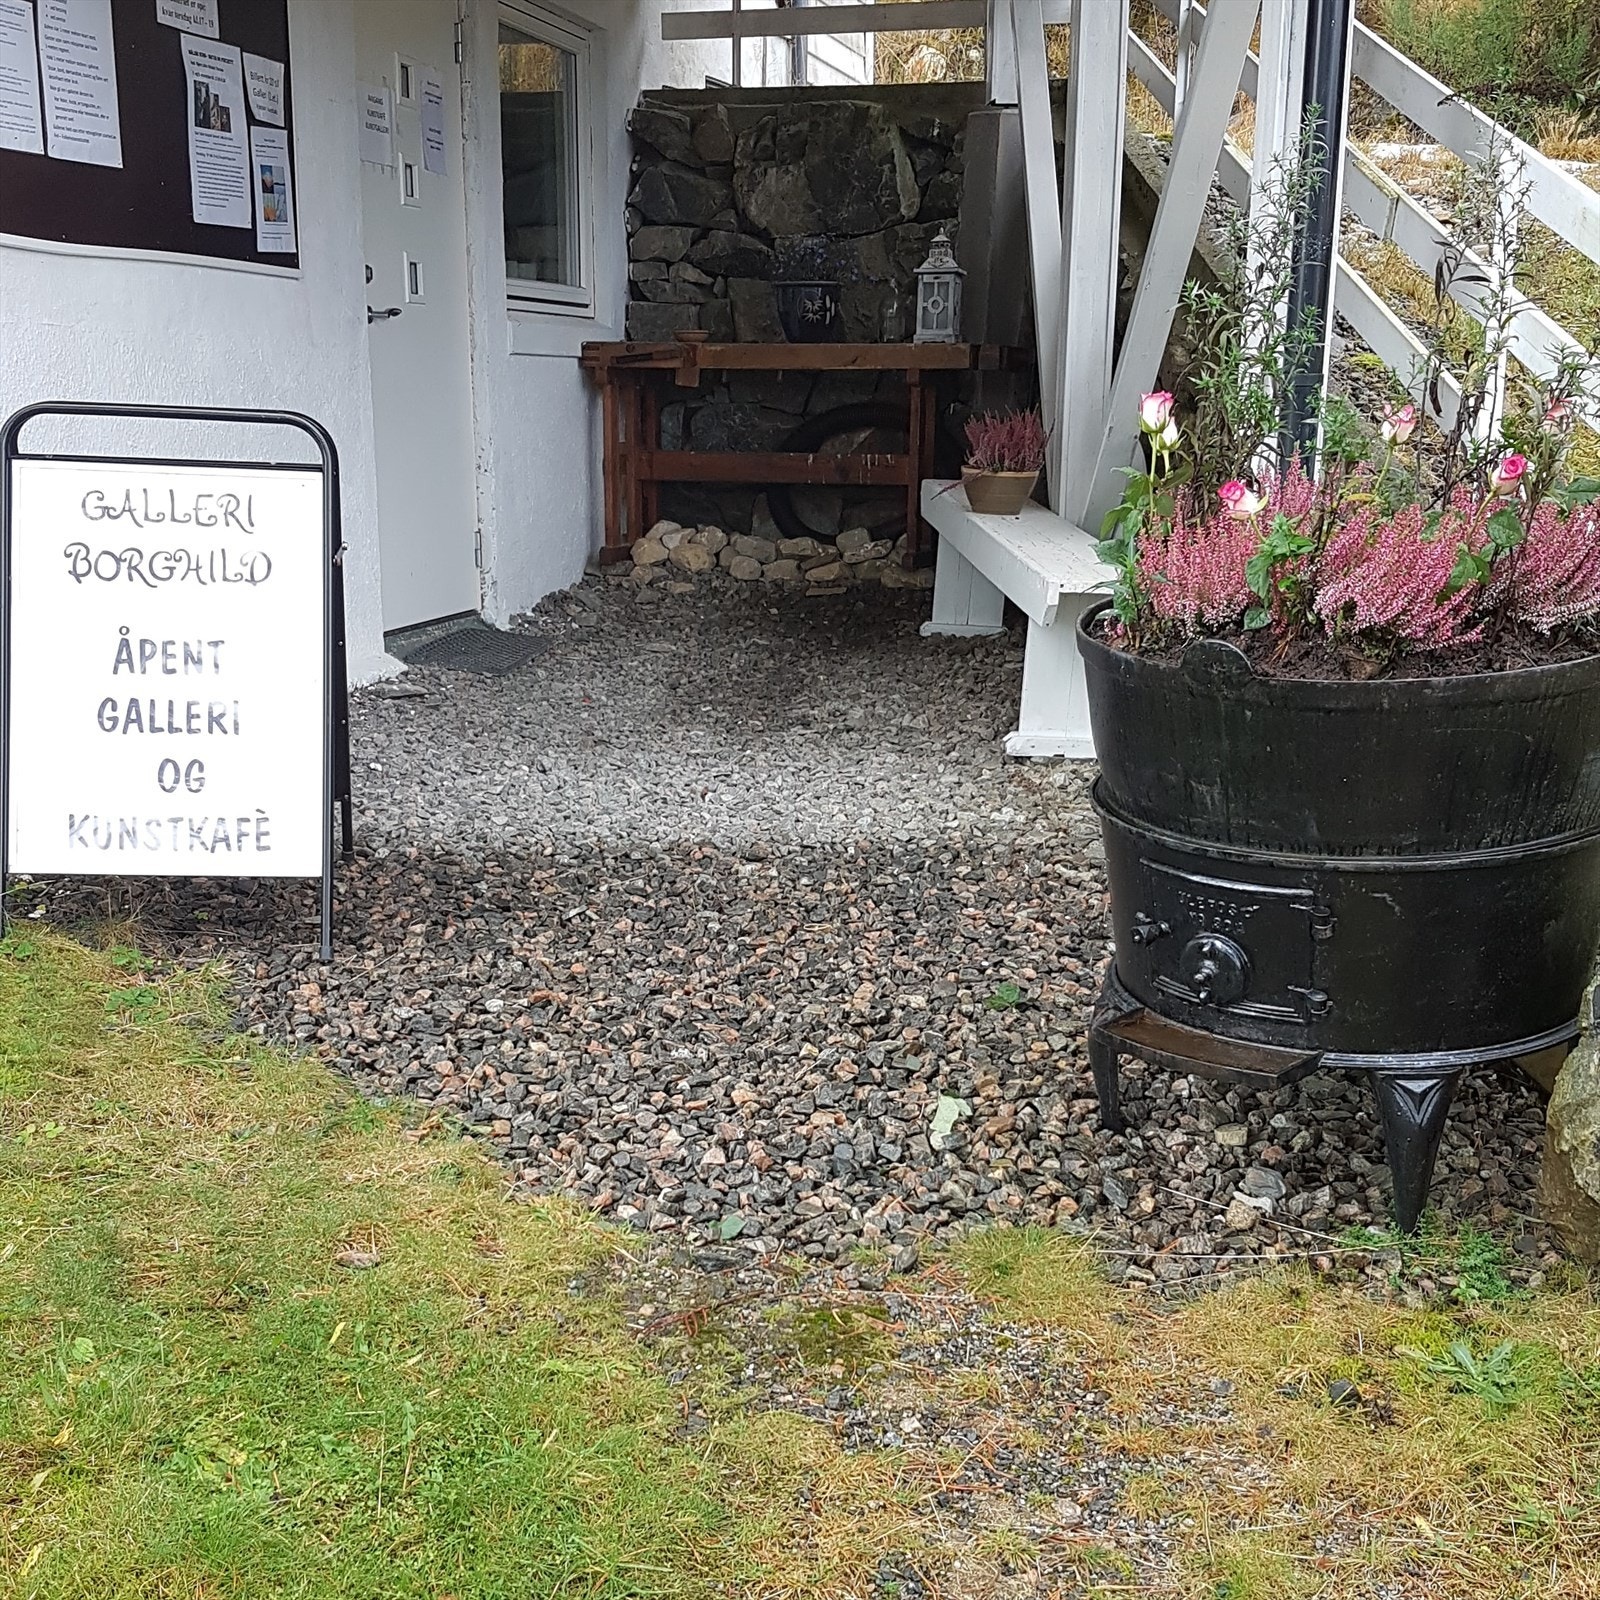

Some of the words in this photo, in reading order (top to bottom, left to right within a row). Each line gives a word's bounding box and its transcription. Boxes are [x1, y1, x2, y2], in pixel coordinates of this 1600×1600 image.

[82, 489, 255, 535] GALLERI
[64, 542, 273, 589] BORGHILD
[113, 626, 226, 676] ÅPENT
[98, 697, 241, 737] GALLERI
[157, 758, 206, 795] OG
